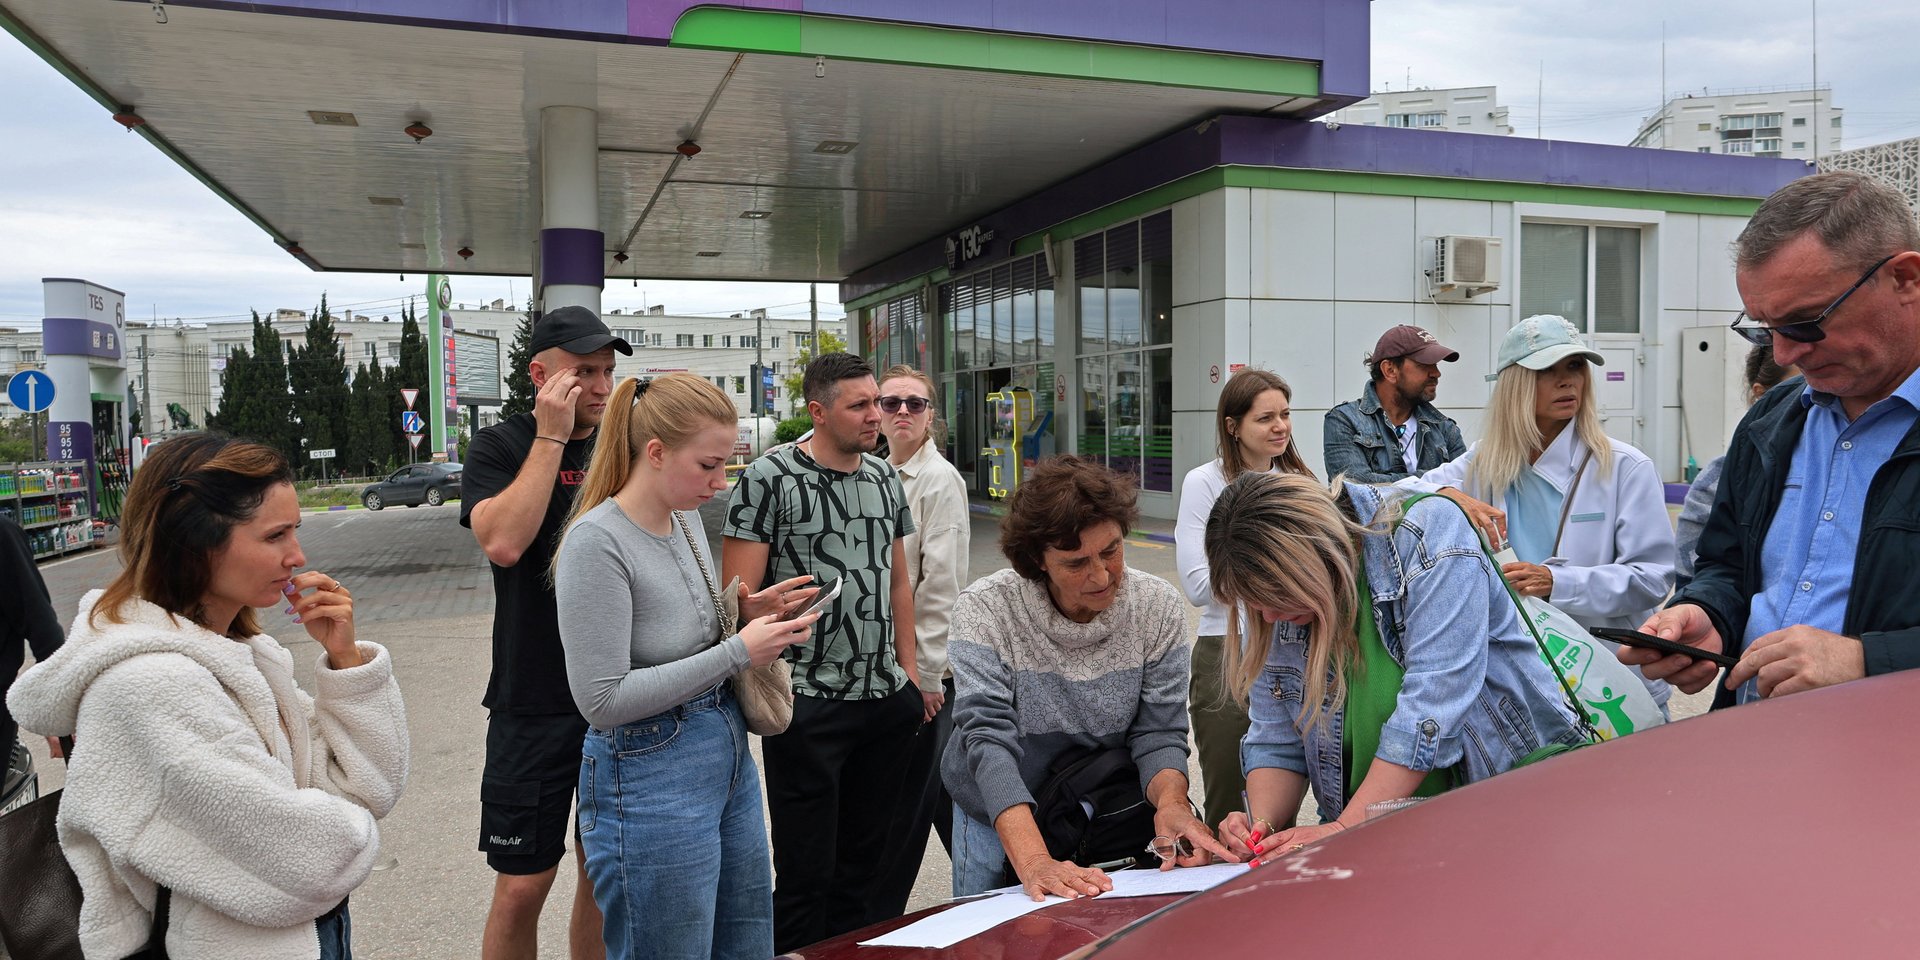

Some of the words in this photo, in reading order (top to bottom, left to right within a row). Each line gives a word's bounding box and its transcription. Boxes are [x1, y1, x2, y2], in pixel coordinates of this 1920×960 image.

[960, 225, 981, 261] ТЭС
[89, 293, 104, 311] TES
[116, 302, 123, 328] 6
[60, 424, 71, 434] 95
[61, 437, 72, 447] 95
[61, 449, 73, 459] 92
